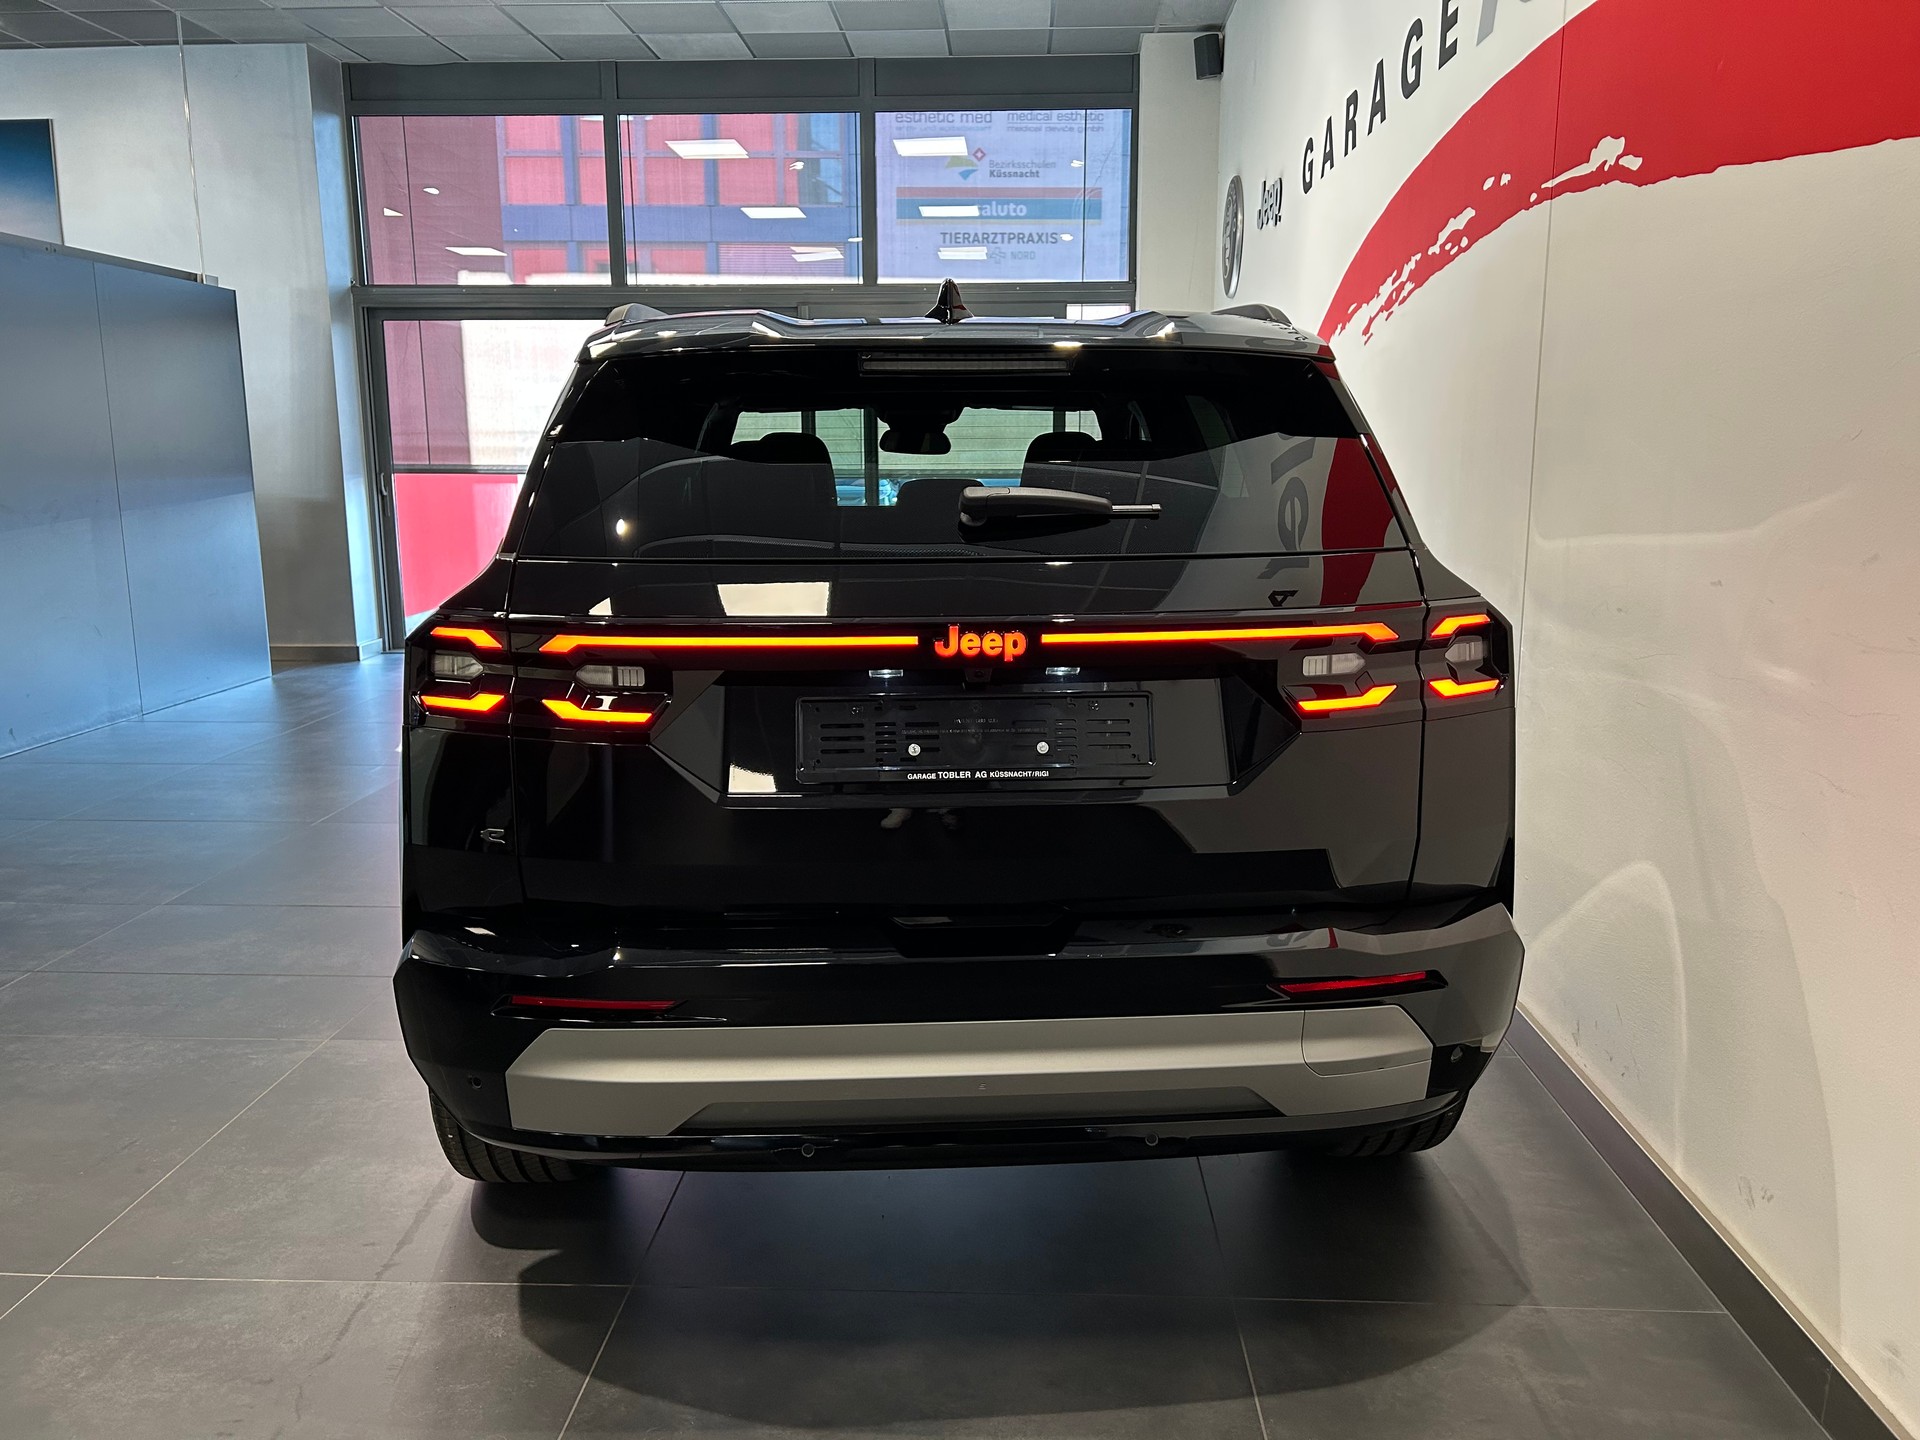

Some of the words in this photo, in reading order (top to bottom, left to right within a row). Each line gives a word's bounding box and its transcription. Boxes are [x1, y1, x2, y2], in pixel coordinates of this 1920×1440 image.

[1302, 0, 1458, 194] GARAGE
[960, 111, 992, 123] med
[1007, 111, 1052, 121] medical
[989, 170, 1040, 178] Küssnacht
[977, 201, 1027, 216] aluto
[1257, 177, 1283, 231] Jeep
[940, 232, 1058, 244] TIERARZTPRAXIS
[1011, 251, 1036, 260] NORD
[934, 625, 1026, 661] Jeep
[938, 771, 971, 779] TOBLER
[990, 770, 1049, 778] KÜSSNACHT/RIGI
